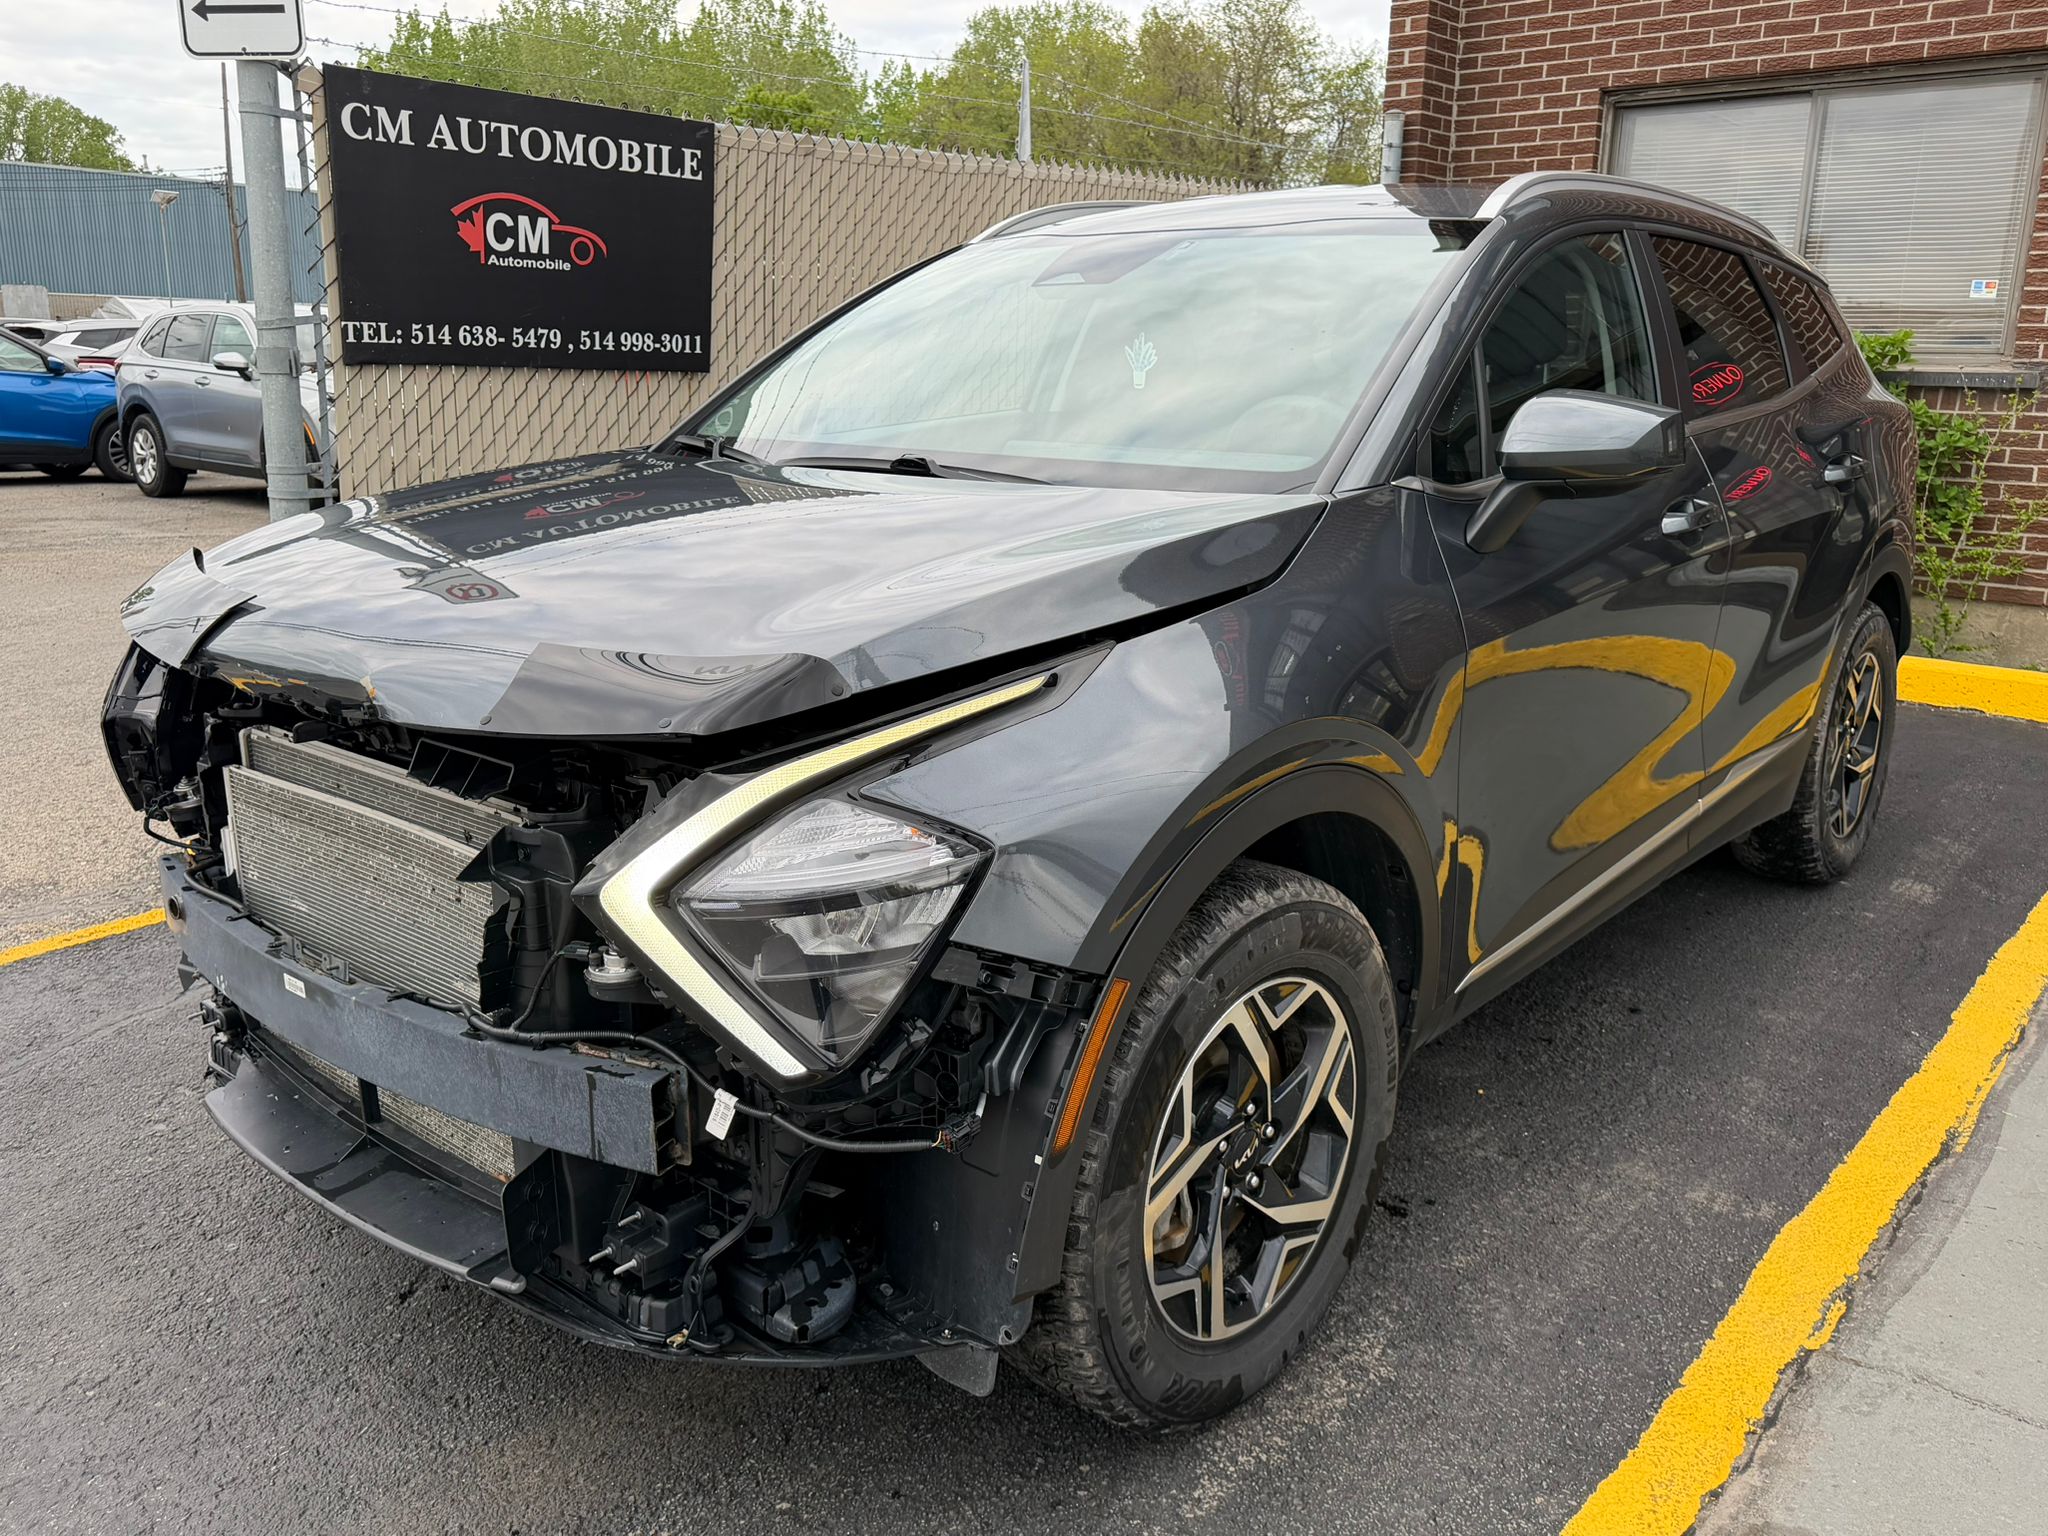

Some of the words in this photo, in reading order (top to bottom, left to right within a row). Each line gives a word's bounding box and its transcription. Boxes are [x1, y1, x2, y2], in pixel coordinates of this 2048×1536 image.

[341, 102, 415, 146] CM
[427, 113, 703, 181] AUTOMOBILE
[486, 212, 550, 255] CM
[487, 254, 572, 271] Automobile
[341, 321, 403, 344] TEL:
[411, 323, 452, 345] 514
[458, 325, 506, 347] 638-
[511, 327, 562, 349] 5479
[579, 330, 616, 351] 514
[620, 332, 703, 354] 998-3011
